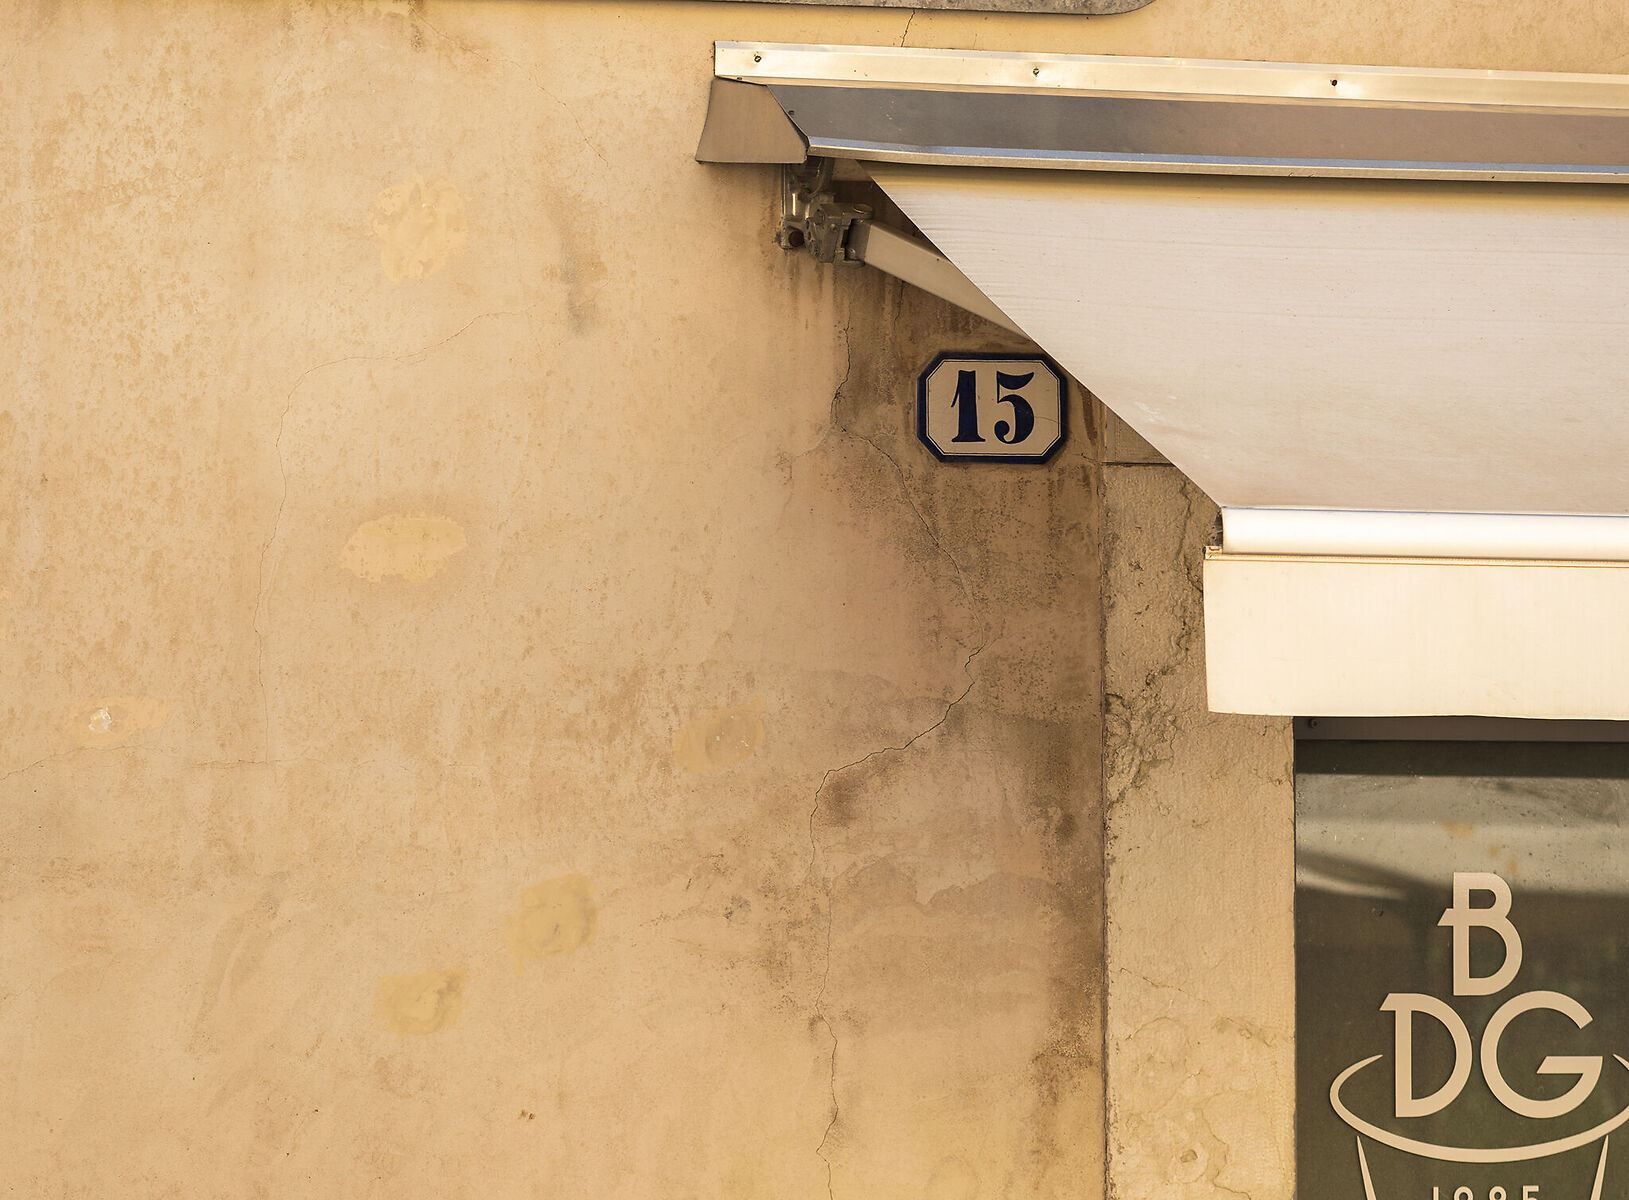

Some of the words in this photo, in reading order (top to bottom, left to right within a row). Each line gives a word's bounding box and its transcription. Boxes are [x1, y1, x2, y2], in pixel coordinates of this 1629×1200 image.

[951, 370, 1034, 444] 15
[1437, 872, 1523, 996] B
[1379, 990, 1603, 1119] DG
